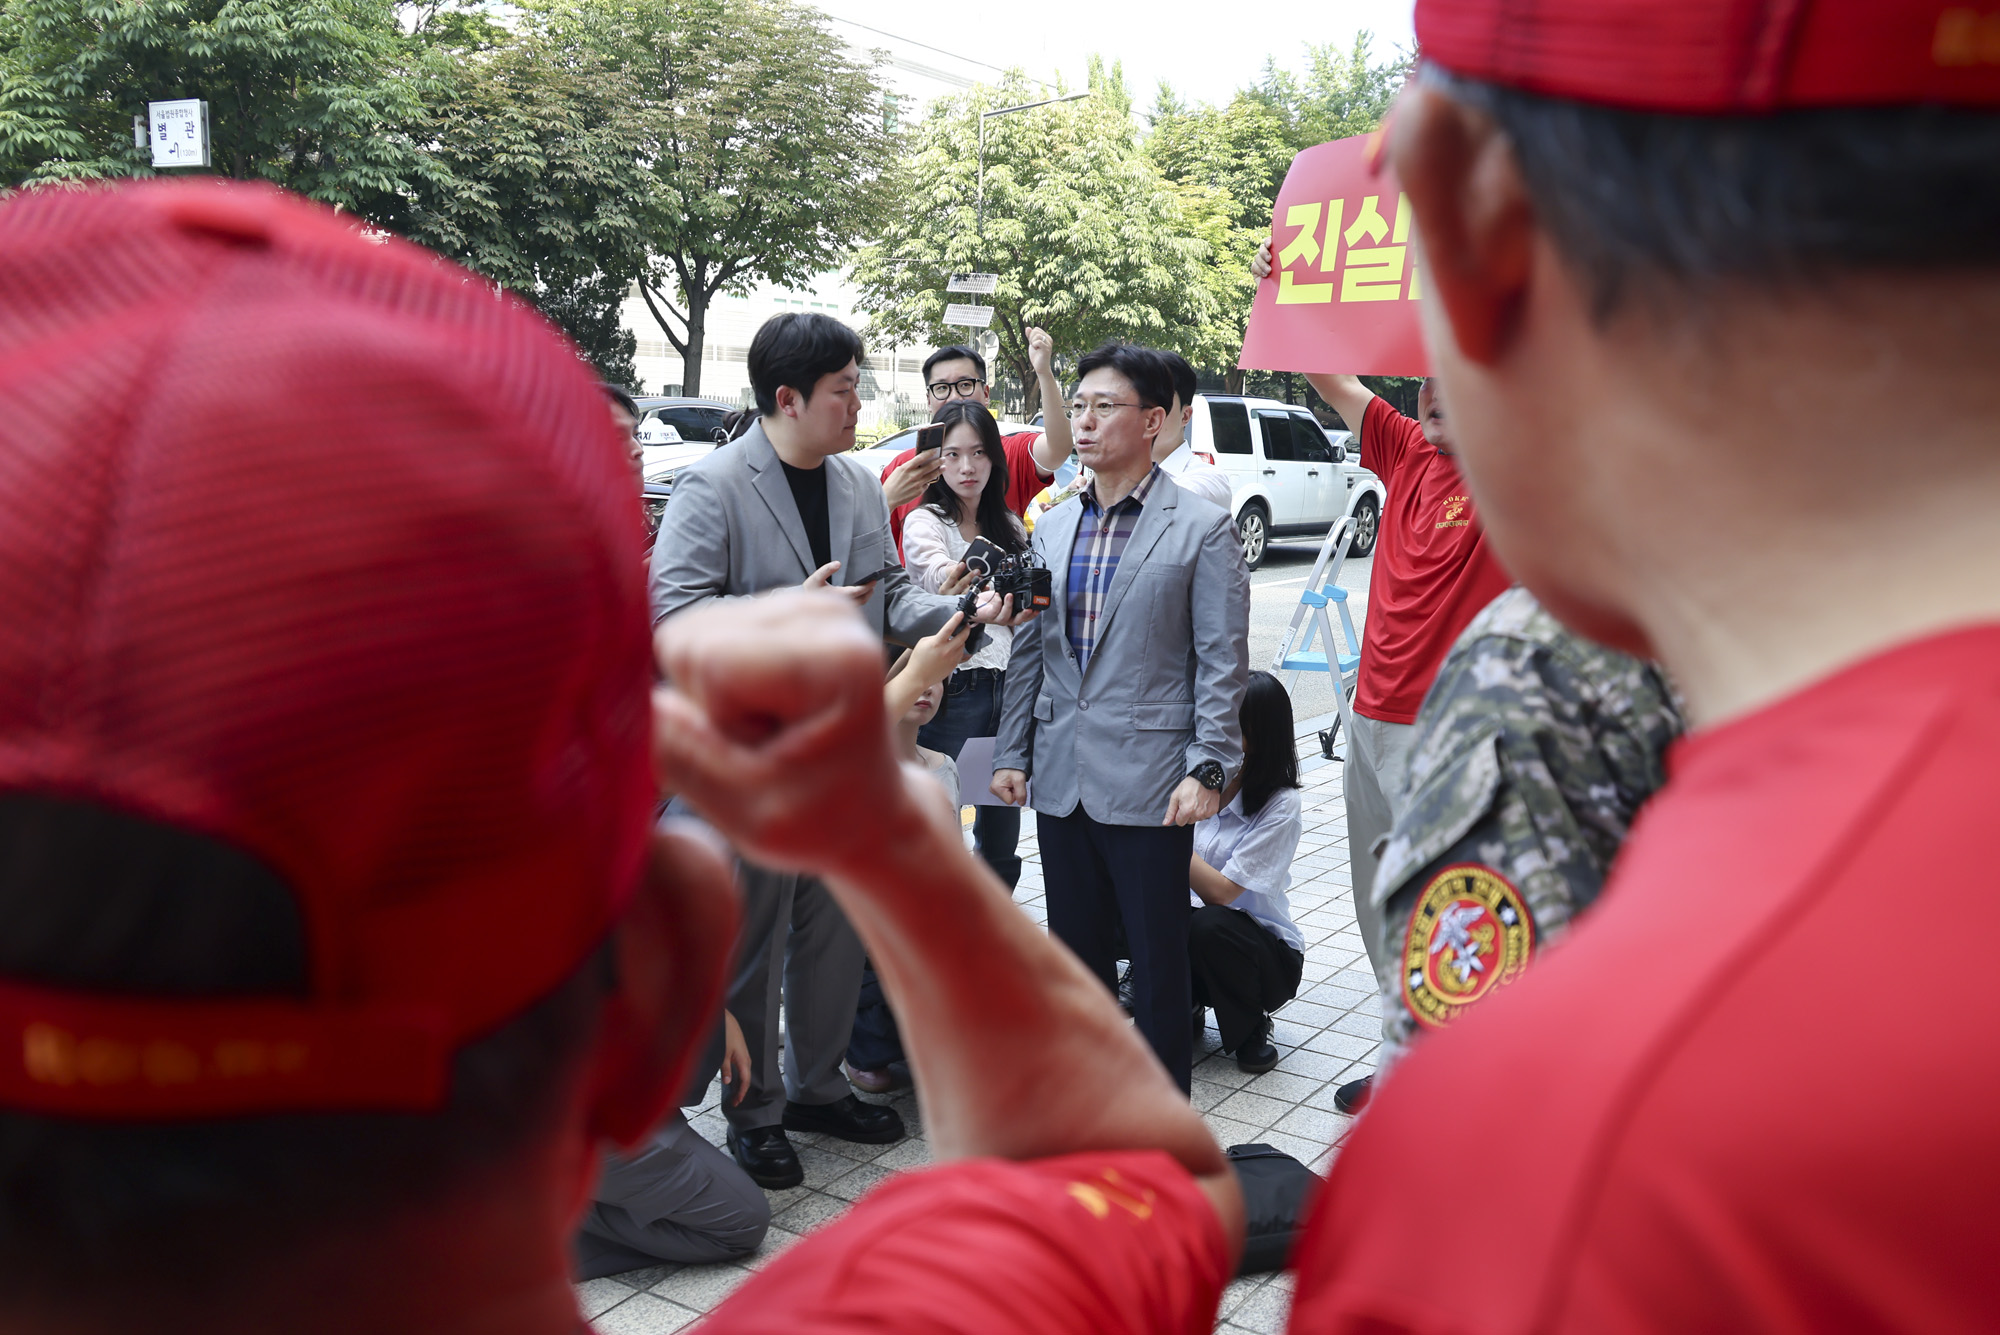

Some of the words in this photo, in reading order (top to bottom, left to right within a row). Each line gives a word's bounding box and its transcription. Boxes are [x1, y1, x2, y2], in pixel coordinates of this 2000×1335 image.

[156, 108, 193, 119] 서울법원종합청사
[157, 122, 167, 141] 별
[184, 120, 195, 139] 관
[1278, 191, 1424, 305] 진실
